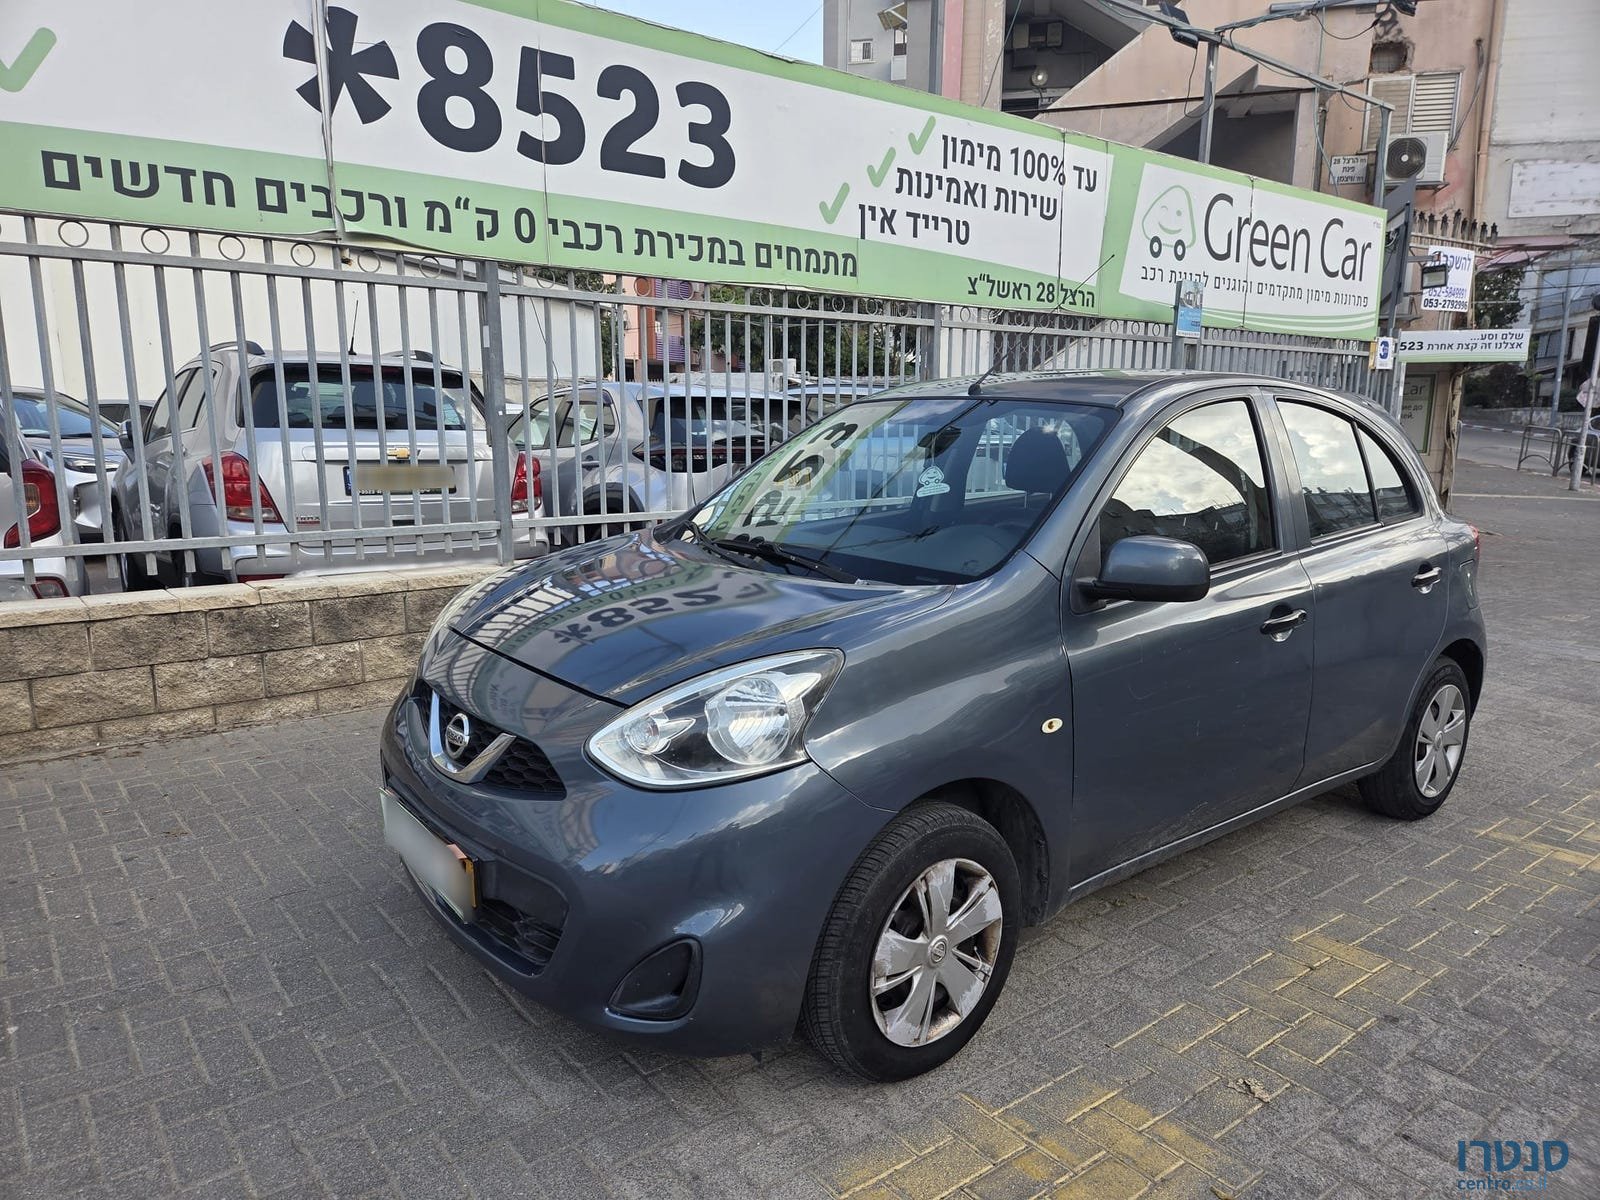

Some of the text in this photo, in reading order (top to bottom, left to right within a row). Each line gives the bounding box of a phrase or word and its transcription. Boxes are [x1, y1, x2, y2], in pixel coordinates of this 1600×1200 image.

[942, 134, 1098, 193] עד 100% מימון
[41, 149, 237, 209] חדשים
[255, 176, 408, 229] ורכבים
[895, 167, 1058, 221] שירות ואמינות
[514, 207, 536, 244] 0
[548, 217, 623, 254] רכבי
[858, 204, 970, 246] טרייד אין
[1204, 191, 1372, 282] Green Car
[634, 228, 745, 266] במכירת
[755, 242, 858, 278] מתמחים
[1431, 254, 1472, 272] להשכר
[1141, 265, 1164, 283] רכב
[1213, 275, 1253, 294] והוגנים
[1036, 281, 1055, 304] 28
[1060, 283, 1095, 308] הרצל
[1257, 282, 1303, 301] מתקדמים
[1307, 288, 1331, 304] מימון
[1333, 292, 1369, 308] פתרונות
[1427, 343, 1454, 351] אחרת
[1456, 342, 1478, 352] קצת
[1480, 342, 1492, 350] זה
[1494, 341, 1523, 350] אצלנו
[1501, 331, 1524, 341] שלם
